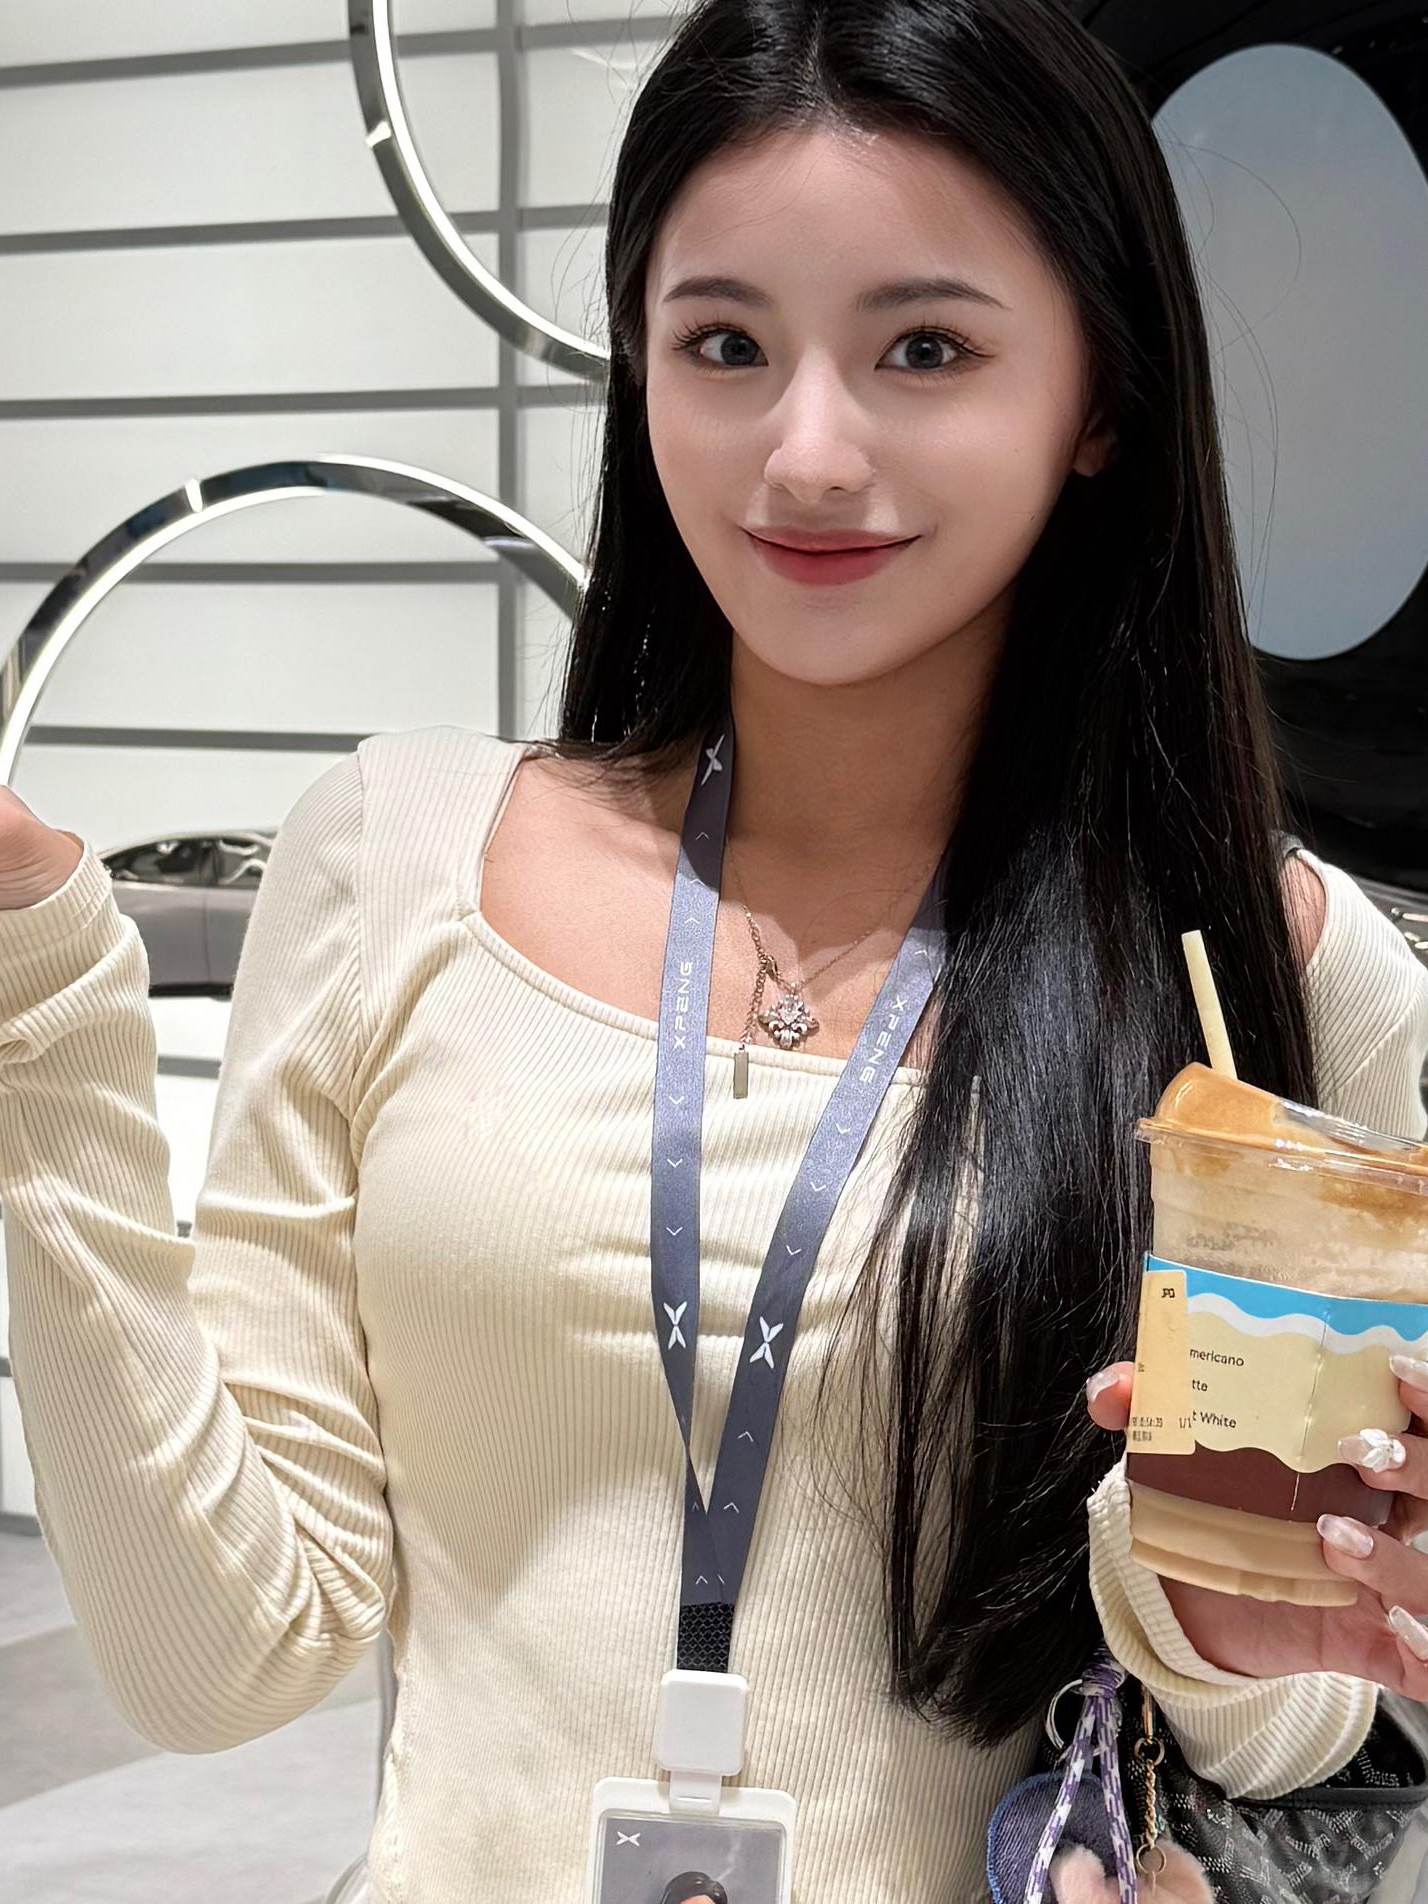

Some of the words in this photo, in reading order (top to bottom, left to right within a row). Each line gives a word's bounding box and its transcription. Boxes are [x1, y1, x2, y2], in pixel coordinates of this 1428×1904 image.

[674, 961, 693, 1050] XPENG
[859, 996, 908, 1085] XPENG
[1189, 1348, 1245, 1367] mericano
[1191, 1379, 1208, 1392] tte
[1199, 1412, 1237, 1428] White
